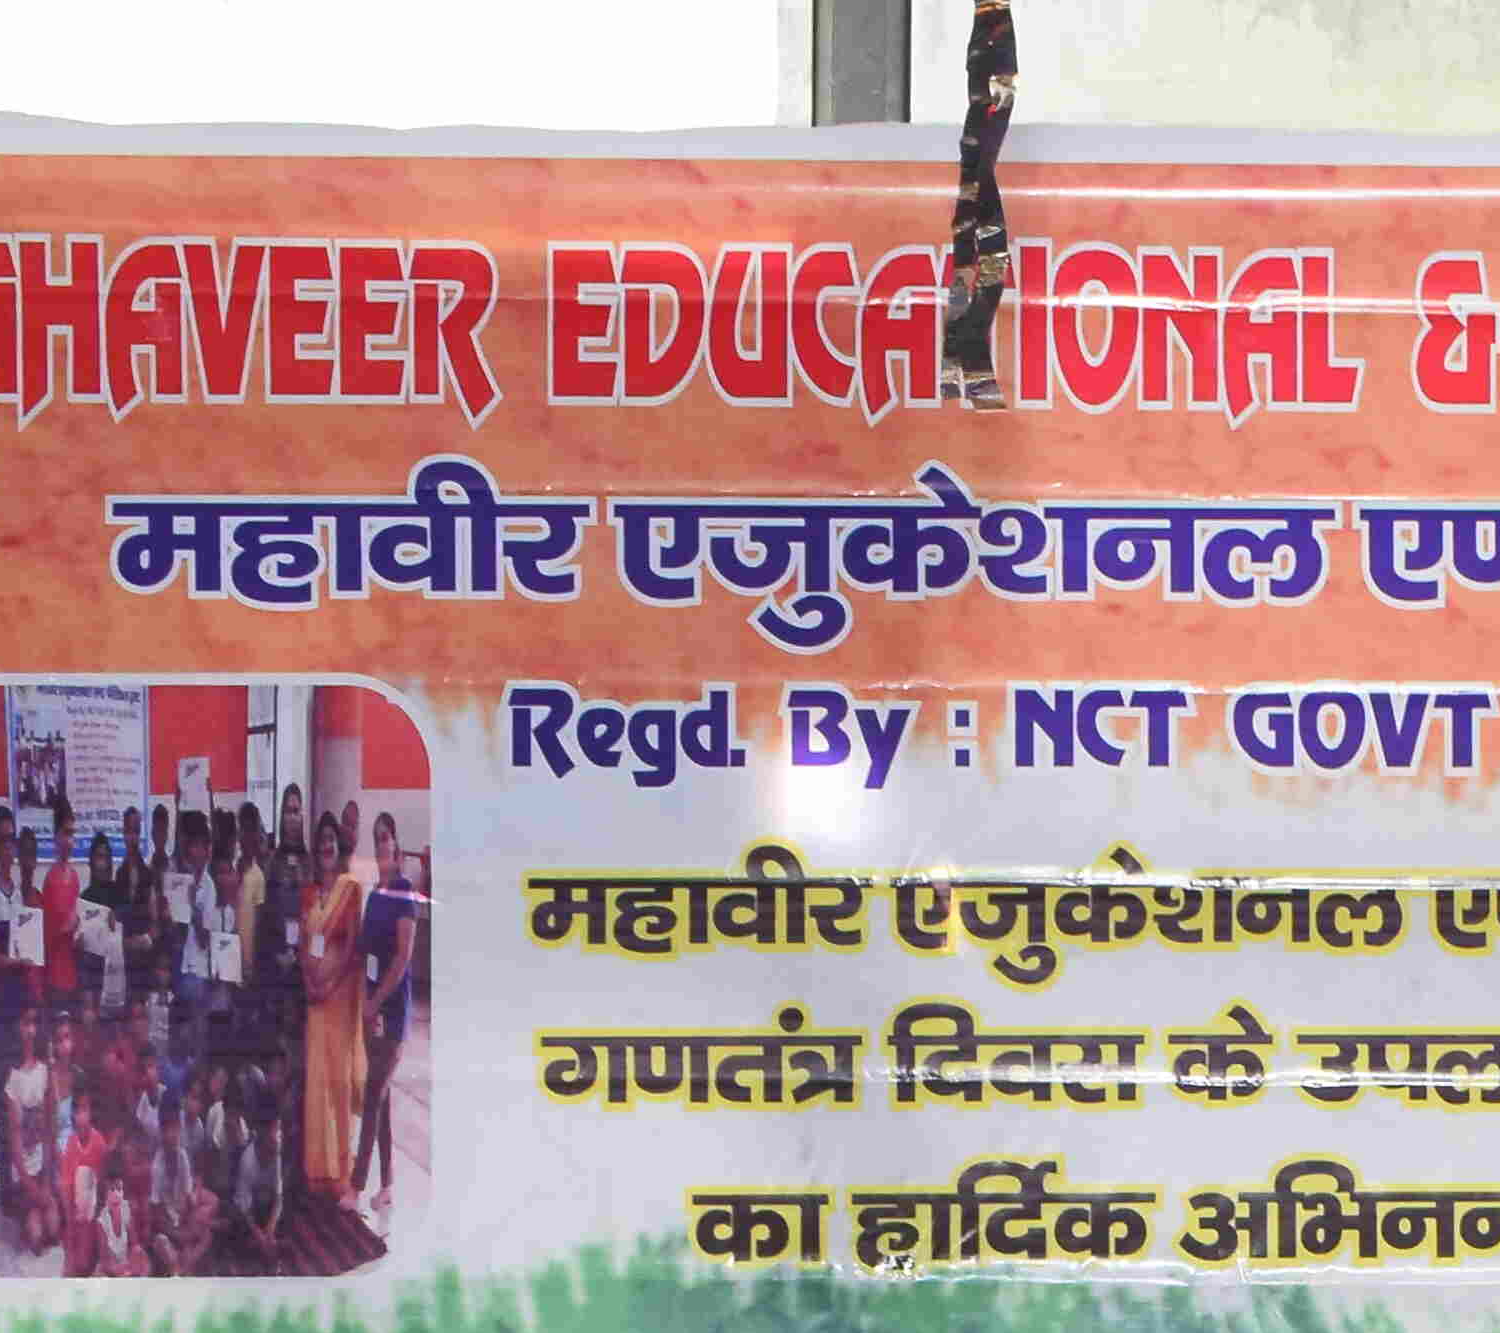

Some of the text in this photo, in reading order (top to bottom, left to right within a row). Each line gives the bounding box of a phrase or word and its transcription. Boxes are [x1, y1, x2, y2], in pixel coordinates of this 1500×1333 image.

[546, 236, 1358, 426] EDUCAIONAL
[1414, 250, 1498, 412] &
[110, 458, 592, 606] महावीर
[610, 464, 1338, 650] एजुकेशनल
[507, 686, 746, 786] Regd.
[786, 688, 912, 790] By
[1013, 688, 1190, 768] NCT
[1233, 688, 1490, 769] GOVT
[528, 845, 866, 953] महावीर
[890, 848, 1404, 984] एजुकेशनल
[540, 1007, 862, 1103] गणतंत्र
[887, 1003, 1145, 1102] दिवस
[1168, 1005, 1274, 1101] के
[693, 1194, 830, 1262] का
[853, 1162, 1156, 1268] हार्दिक
